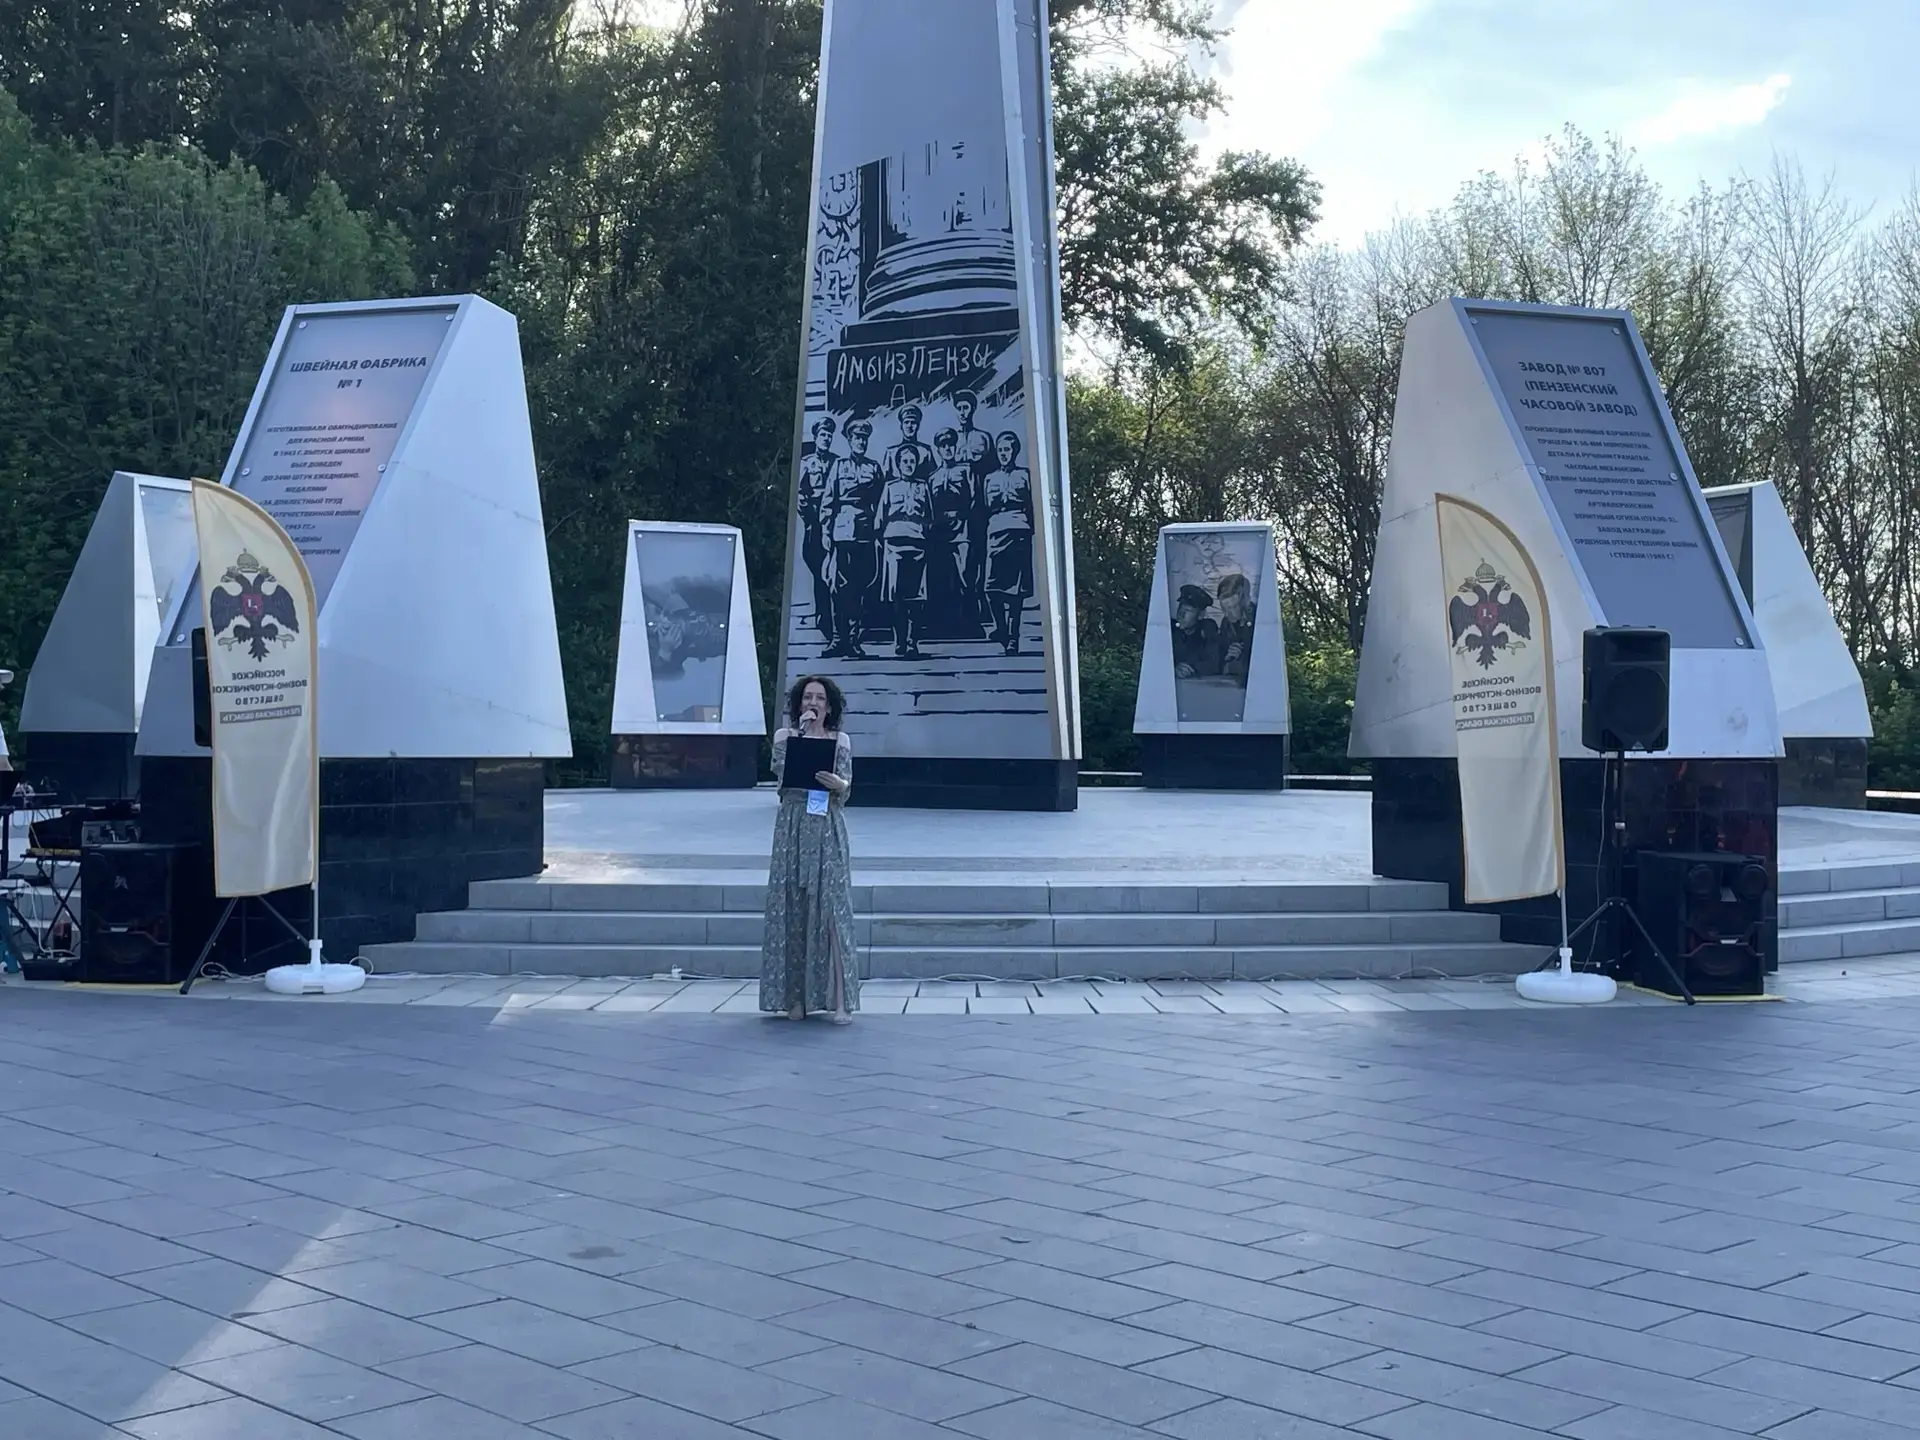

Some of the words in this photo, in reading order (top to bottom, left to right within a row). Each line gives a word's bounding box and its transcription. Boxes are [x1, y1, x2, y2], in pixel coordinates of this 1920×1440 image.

[290, 360, 358, 372] ШВЕЙНАЯ
[360, 356, 427, 370] ФАБРИКА
[1518, 361, 1567, 376] ЗАВОД
[1567, 365, 1580, 374] №
[1583, 366, 1606, 377] 807
[356, 378, 362, 388] 1
[1524, 380, 1618, 396] (ПЕНЗЕНСКИЙ
[1520, 398, 1586, 412] ЧАСОВОЙ
[1587, 402, 1638, 416] ЗАВОД)
[324, 498, 343, 506] ТРУД
